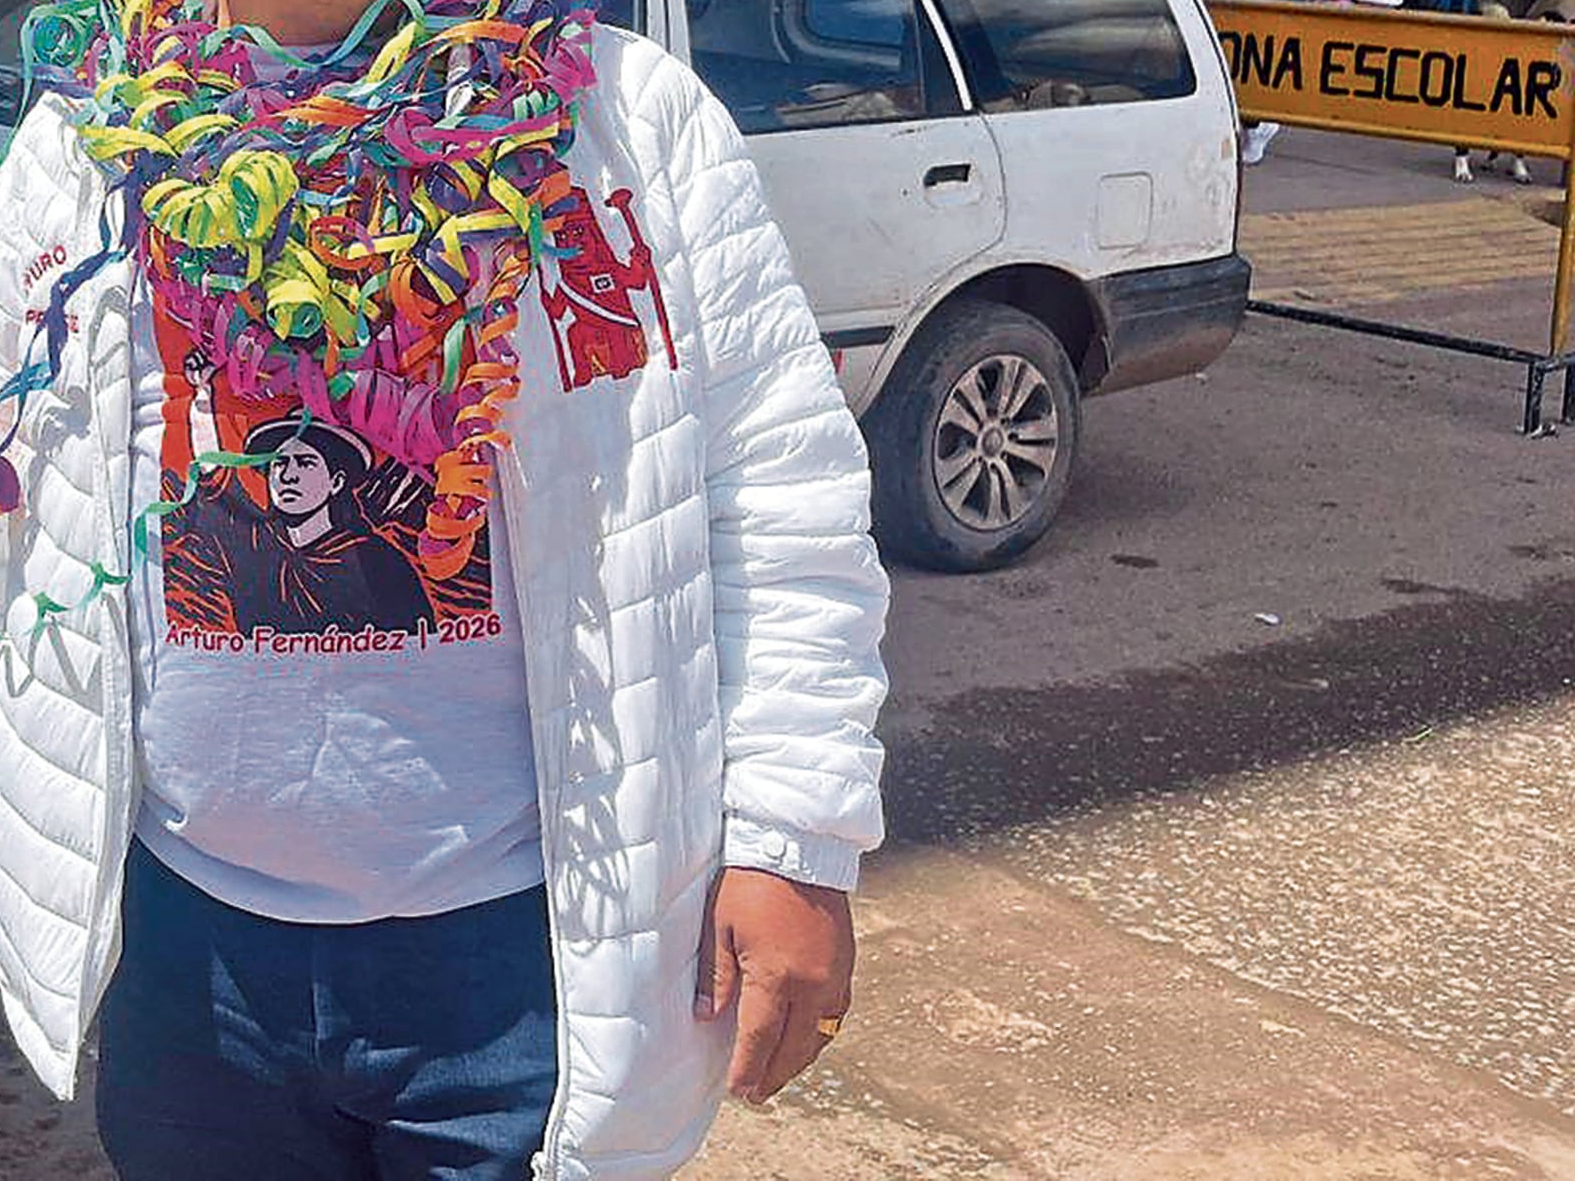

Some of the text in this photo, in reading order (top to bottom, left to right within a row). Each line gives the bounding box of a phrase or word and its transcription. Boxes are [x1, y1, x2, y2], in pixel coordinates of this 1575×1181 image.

[1218, 31, 1562, 119] ONA ESCOLAR
[165, 623, 245, 652] Arturo
[254, 624, 407, 653] Fernández
[439, 614, 502, 644] 2026
